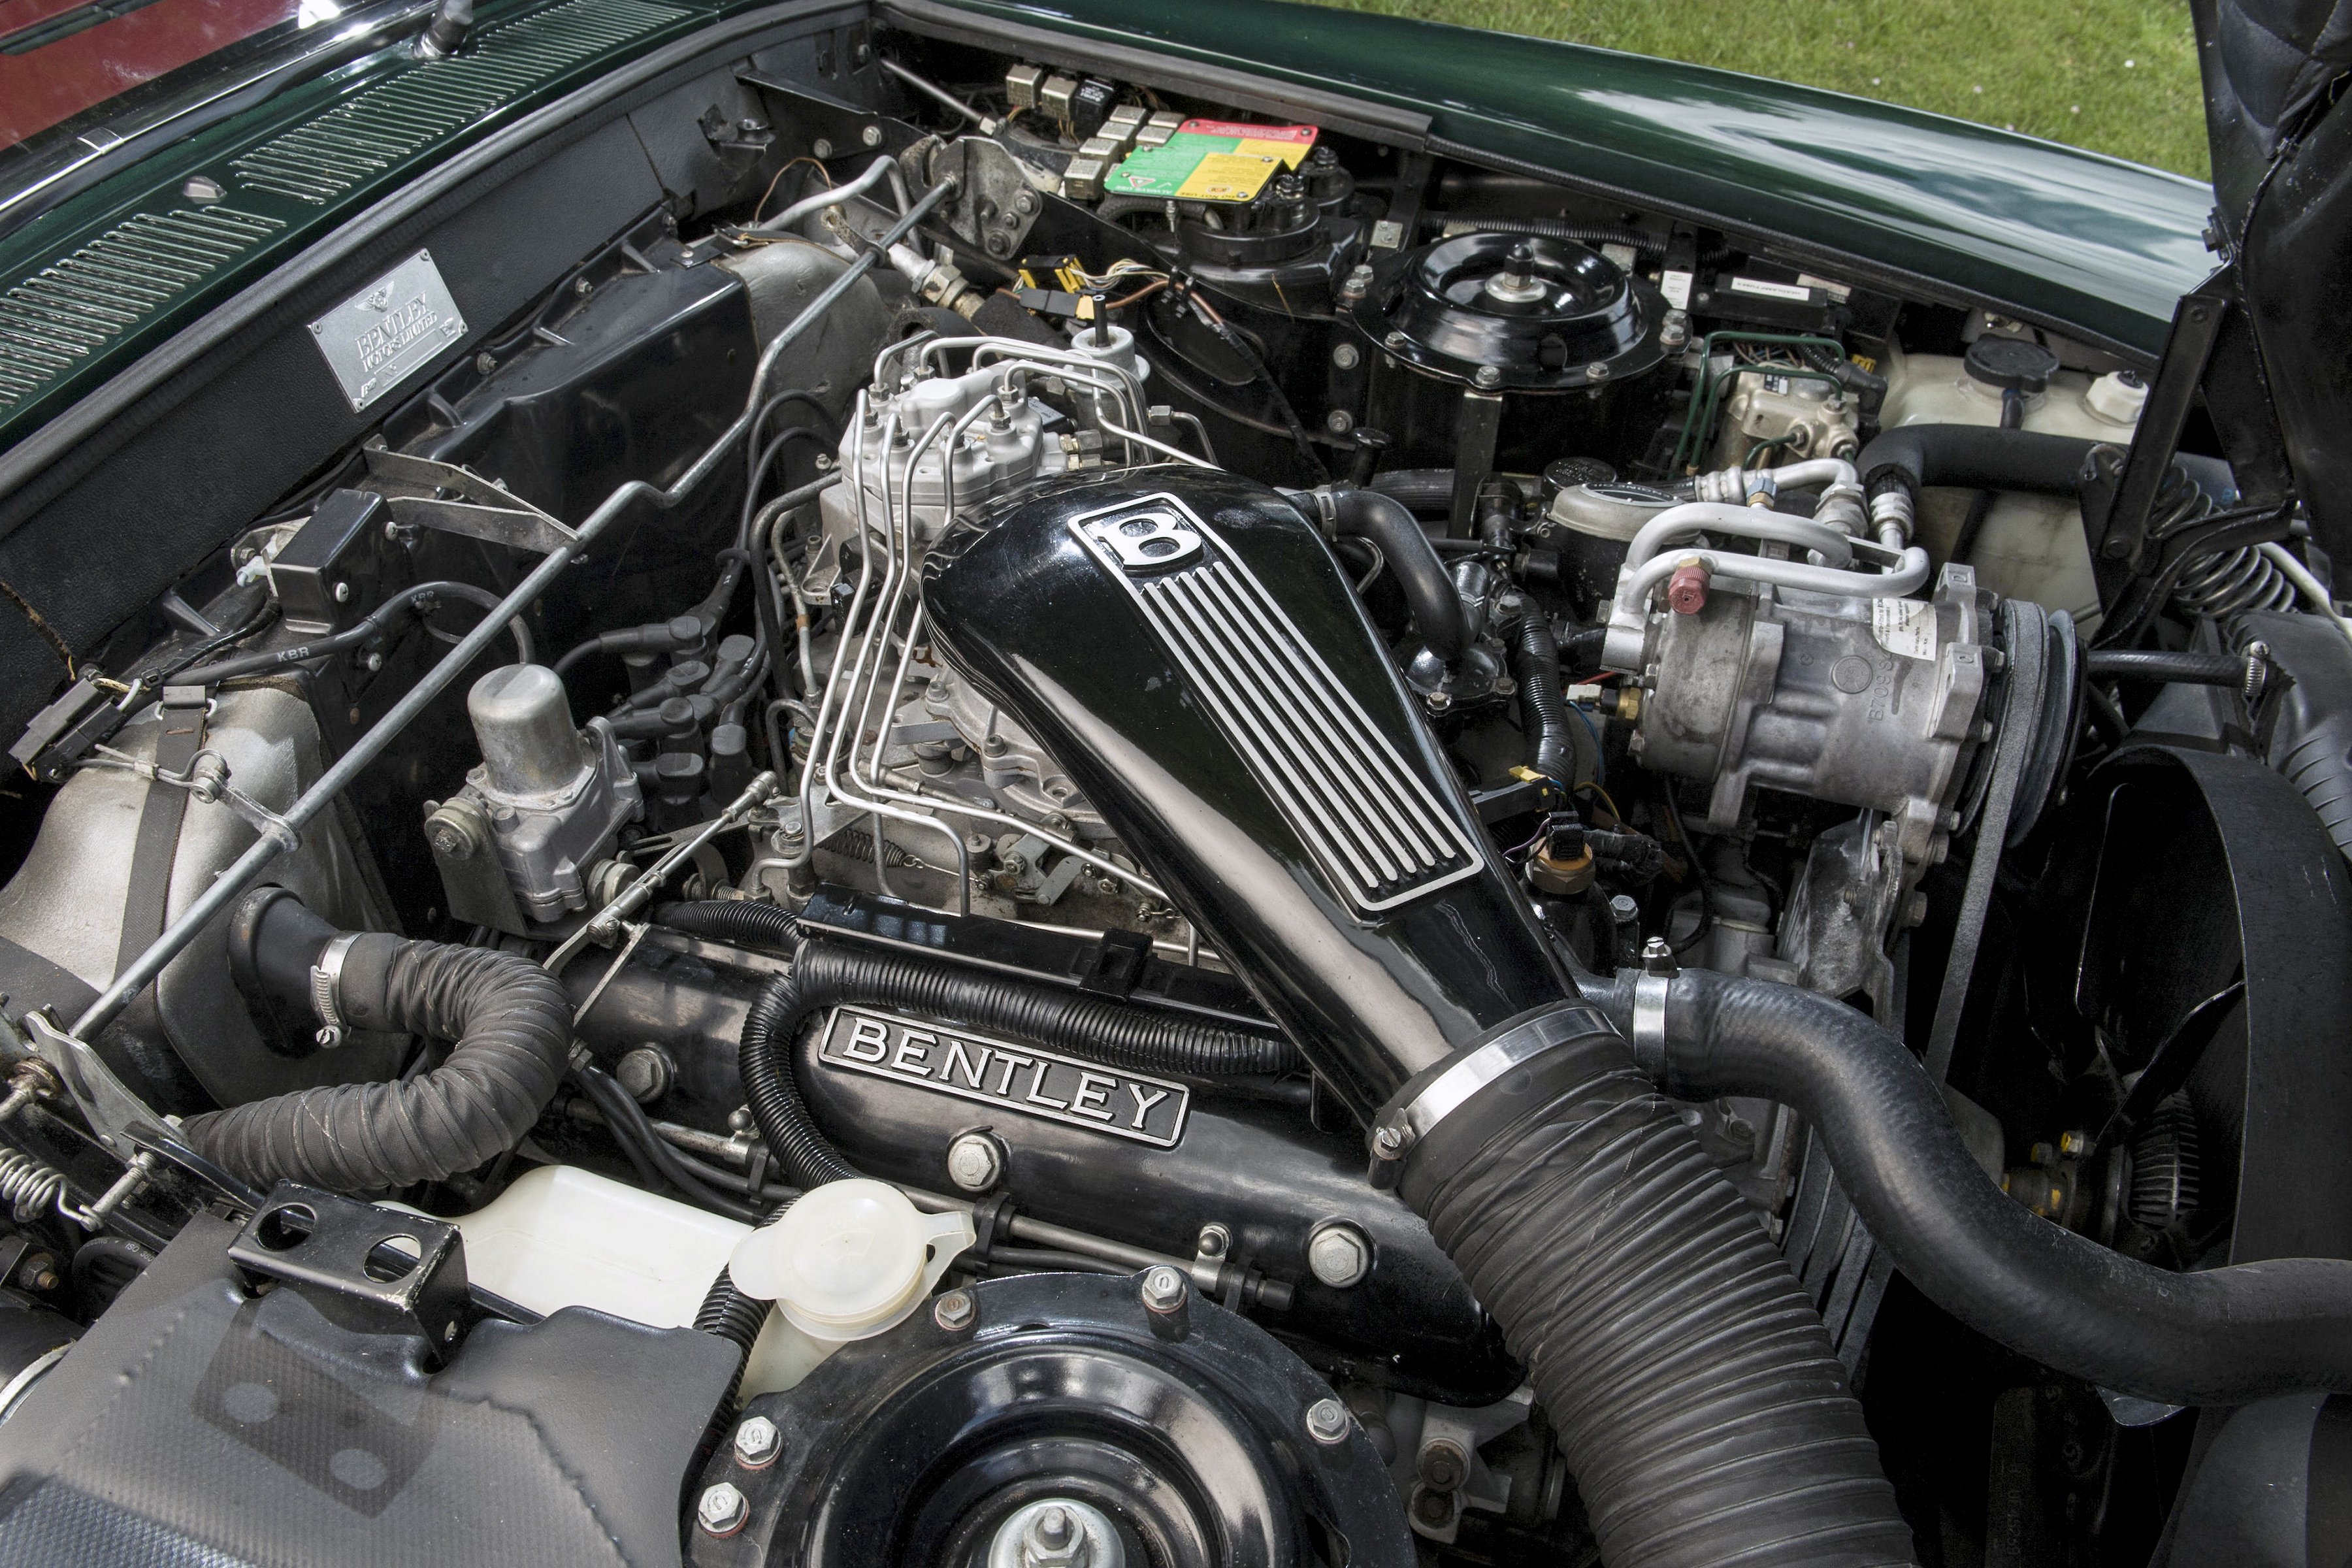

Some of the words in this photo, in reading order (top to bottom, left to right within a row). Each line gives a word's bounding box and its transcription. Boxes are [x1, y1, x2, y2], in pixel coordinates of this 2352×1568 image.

[1760, 287, 1801, 295] HEADLAMP
[355, 292, 429, 359] BENTLEY
[362, 337, 402, 372] MOTORS
[400, 310, 438, 345] LIMITED
[1618, 485, 1671, 498] ENGINE
[1098, 513, 1202, 566] B
[276, 646, 310, 662] KBR
[842, 1017, 1169, 1129] BENTLEY
[124, 1241, 140, 1253] ISO
